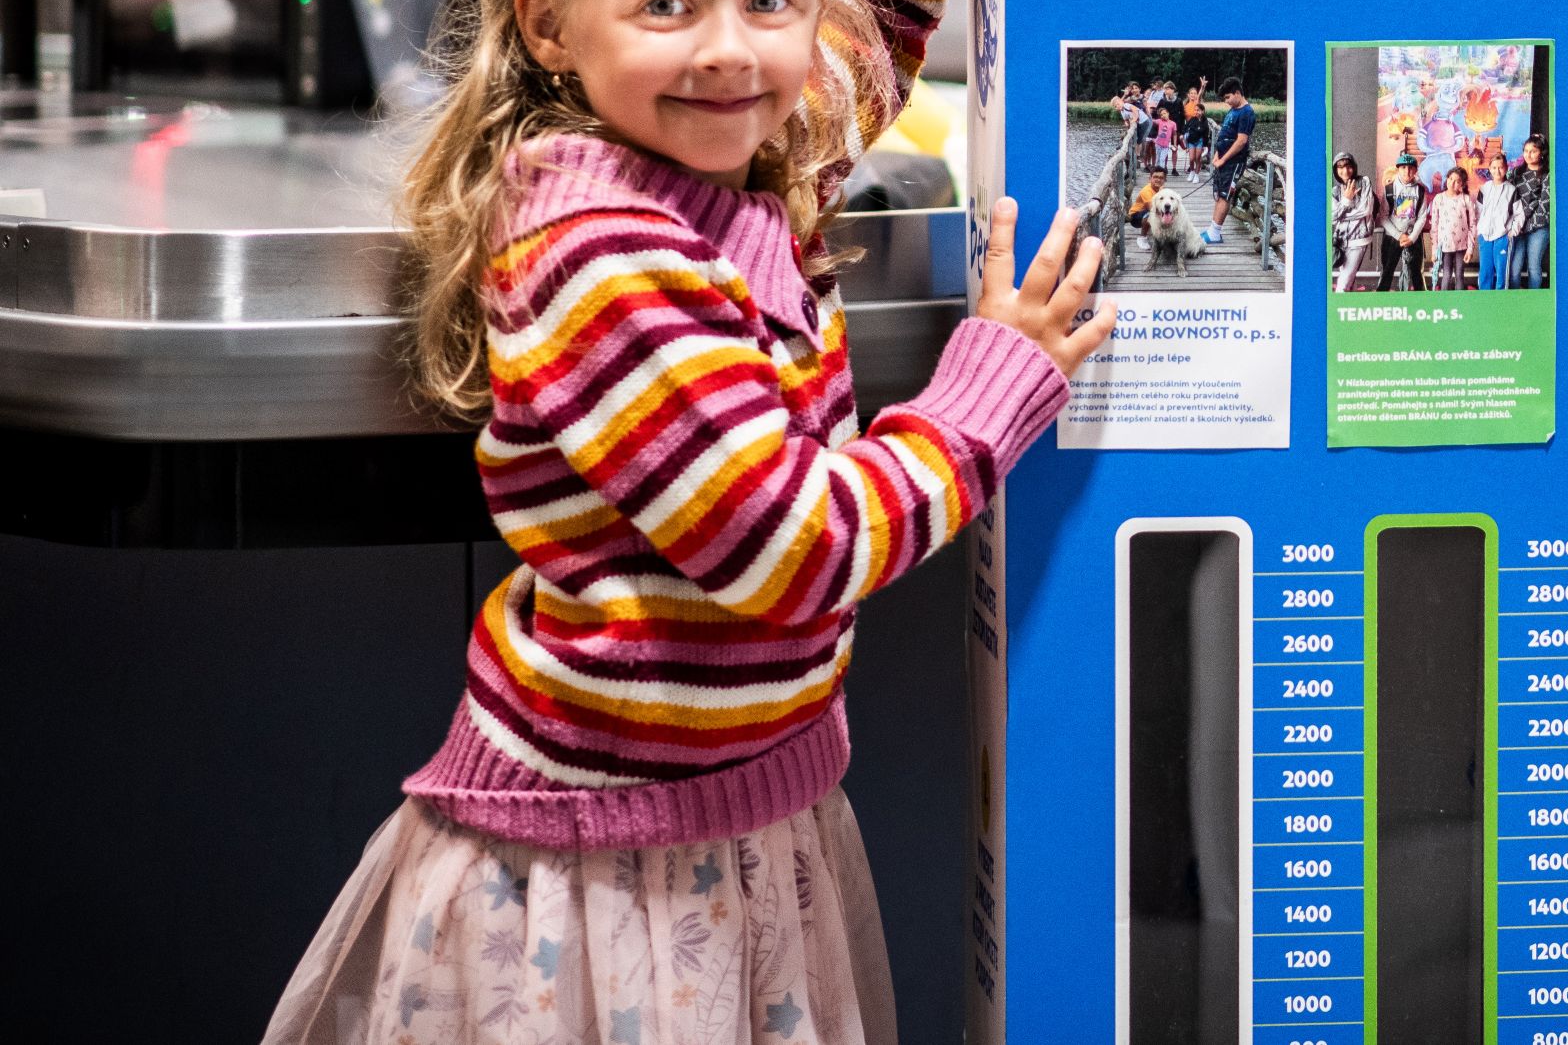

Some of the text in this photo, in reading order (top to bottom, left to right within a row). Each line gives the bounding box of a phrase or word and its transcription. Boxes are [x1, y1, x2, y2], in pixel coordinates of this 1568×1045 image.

[1152, 306, 1248, 322] KOMUNITNÍ
[1337, 306, 1412, 322] TEMPERI,
[1152, 327, 1230, 340] ROVNOST
[1084, 353, 1191, 365] oCeRem to jde lépe
[1392, 349, 1432, 361] BRÁNA
[1434, 350, 1449, 361] do
[1451, 349, 1480, 360] světa
[1483, 349, 1522, 361] zábavy
[1100, 380, 1148, 390] ohroženým
[1337, 379, 1344, 387] V
[1415, 378, 1440, 386] klubu
[1441, 377, 1466, 385] Brána
[1390, 390, 1418, 398] dětem
[1460, 400, 1484, 409] Svým
[1486, 399, 1516, 407] hlasem
[1104, 415, 1114, 423] ke
[1379, 412, 1406, 421] dětem
[1408, 411, 1440, 420] BRÁNU
[1441, 411, 1453, 420] do
[1454, 411, 1477, 420] světa
[1282, 544, 1335, 563] 3000
[1282, 589, 1334, 608] 2800
[1283, 634, 1334, 653] 2600
[1283, 679, 1334, 698] 2400
[1283, 724, 1333, 743] 2200
[1282, 769, 1334, 788] 2000
[1283, 815, 1332, 833] 1800
[1284, 860, 1332, 878] 1600
[1284, 905, 1332, 923] 1400
[1285, 950, 1331, 968] 1200
[1284, 995, 1332, 1013] 1000
